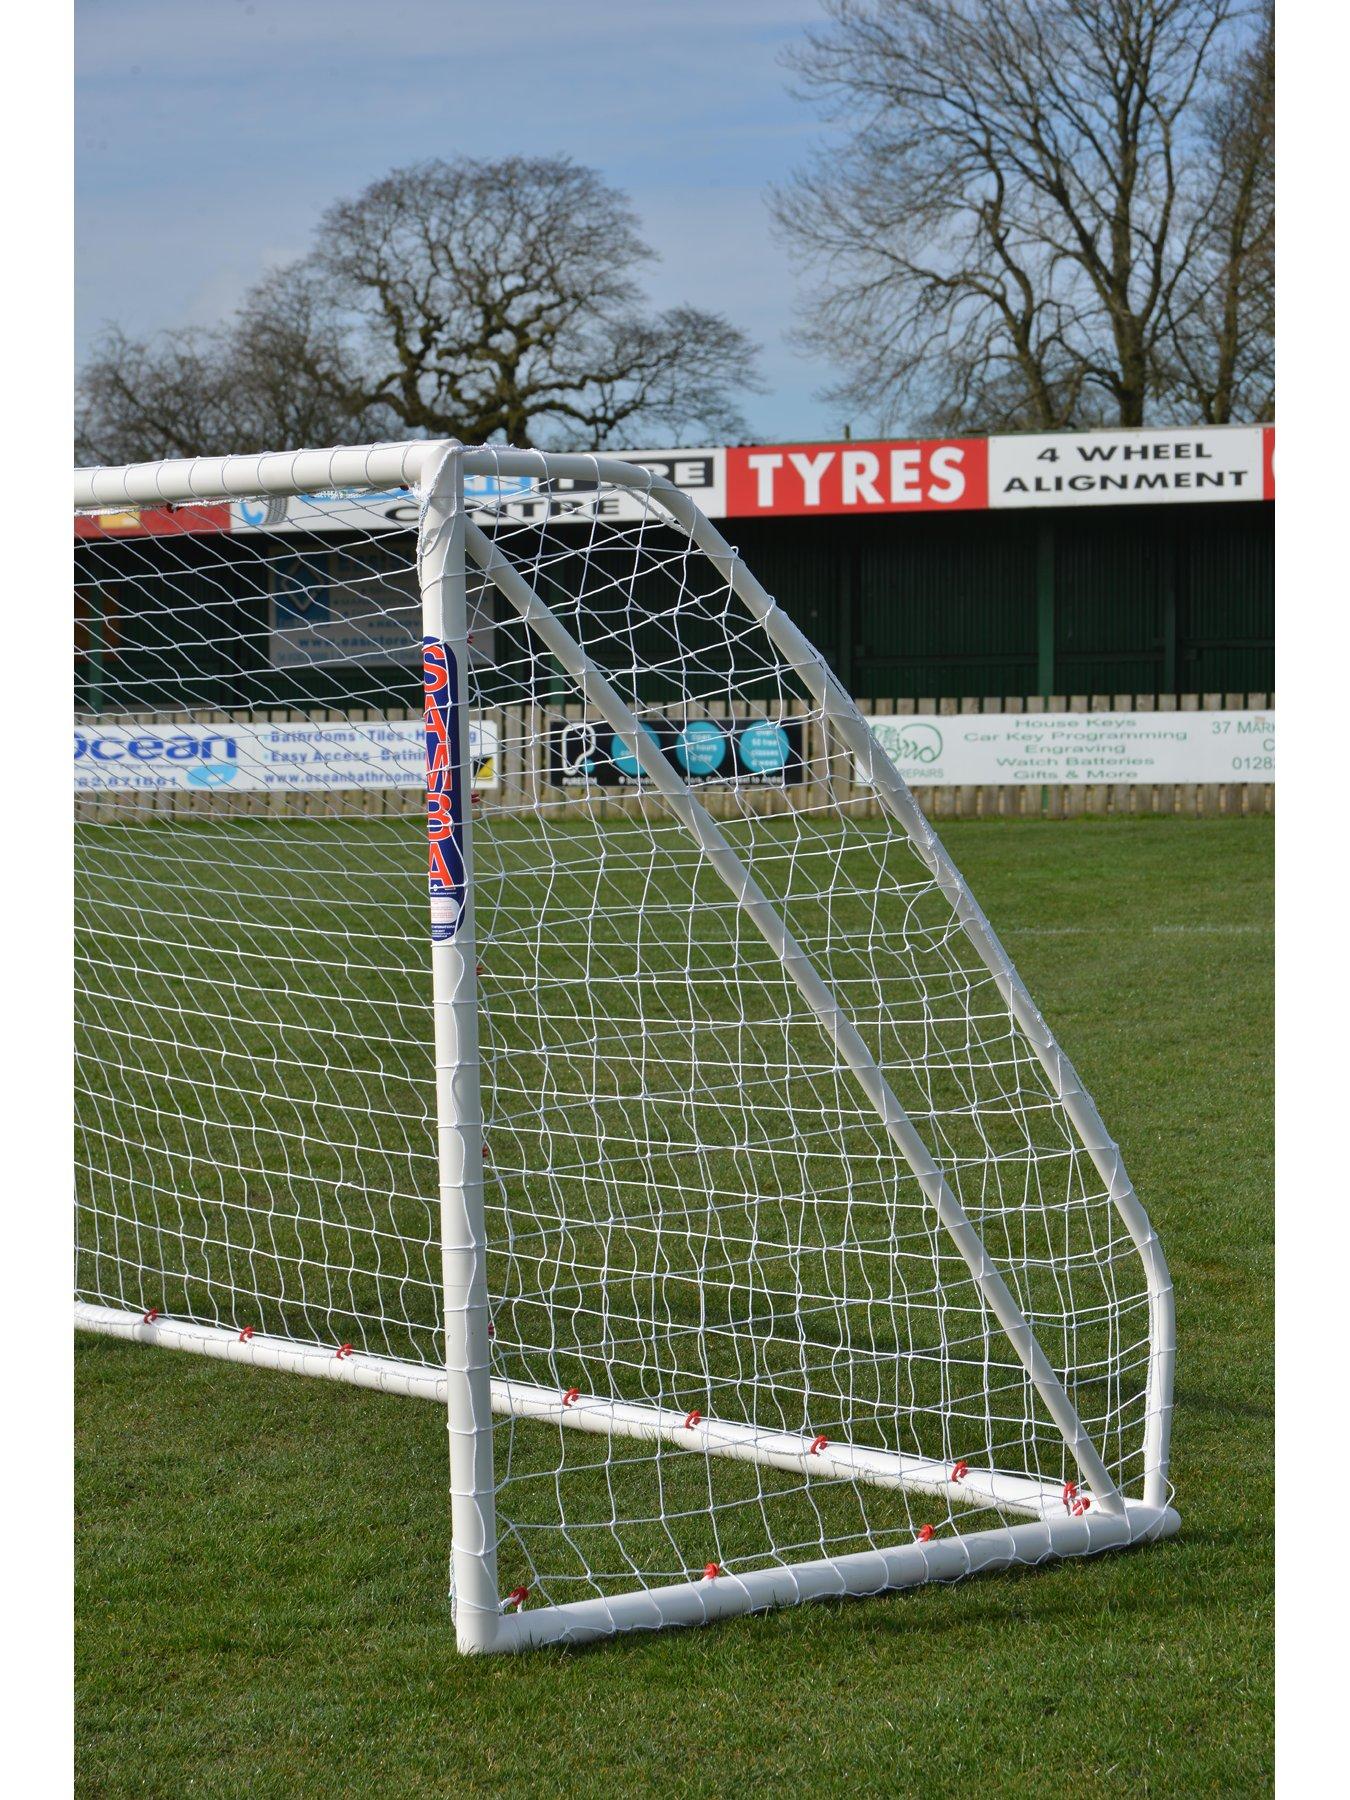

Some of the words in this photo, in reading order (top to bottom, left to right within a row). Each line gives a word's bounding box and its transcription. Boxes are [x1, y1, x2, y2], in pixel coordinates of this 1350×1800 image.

[1037, 447, 1060, 462] 4
[1077, 443, 1212, 462] WHEEL
[749, 446, 966, 507] TYRES
[1003, 471, 1248, 492] ALIGNMENT
[385, 499, 620, 522] CNTRE
[1014, 719, 1078, 729] House
[1086, 718, 1137, 728] Keys
[1212, 721, 1231, 734] 37
[1237, 720, 1275, 734] MAR
[964, 733, 999, 742] Car
[1006, 732, 1044, 743] Key
[1051, 731, 1188, 743] Programming
[1024, 744, 1126, 754] Engraving
[996, 757, 1058, 767] Watch
[1065, 756, 1155, 766] Batteries
[1232, 756, 1275, 769] 0128
[1014, 769, 1058, 779] Gifts
[1065, 770, 1079, 779] &
[1086, 769, 1138, 779] More
